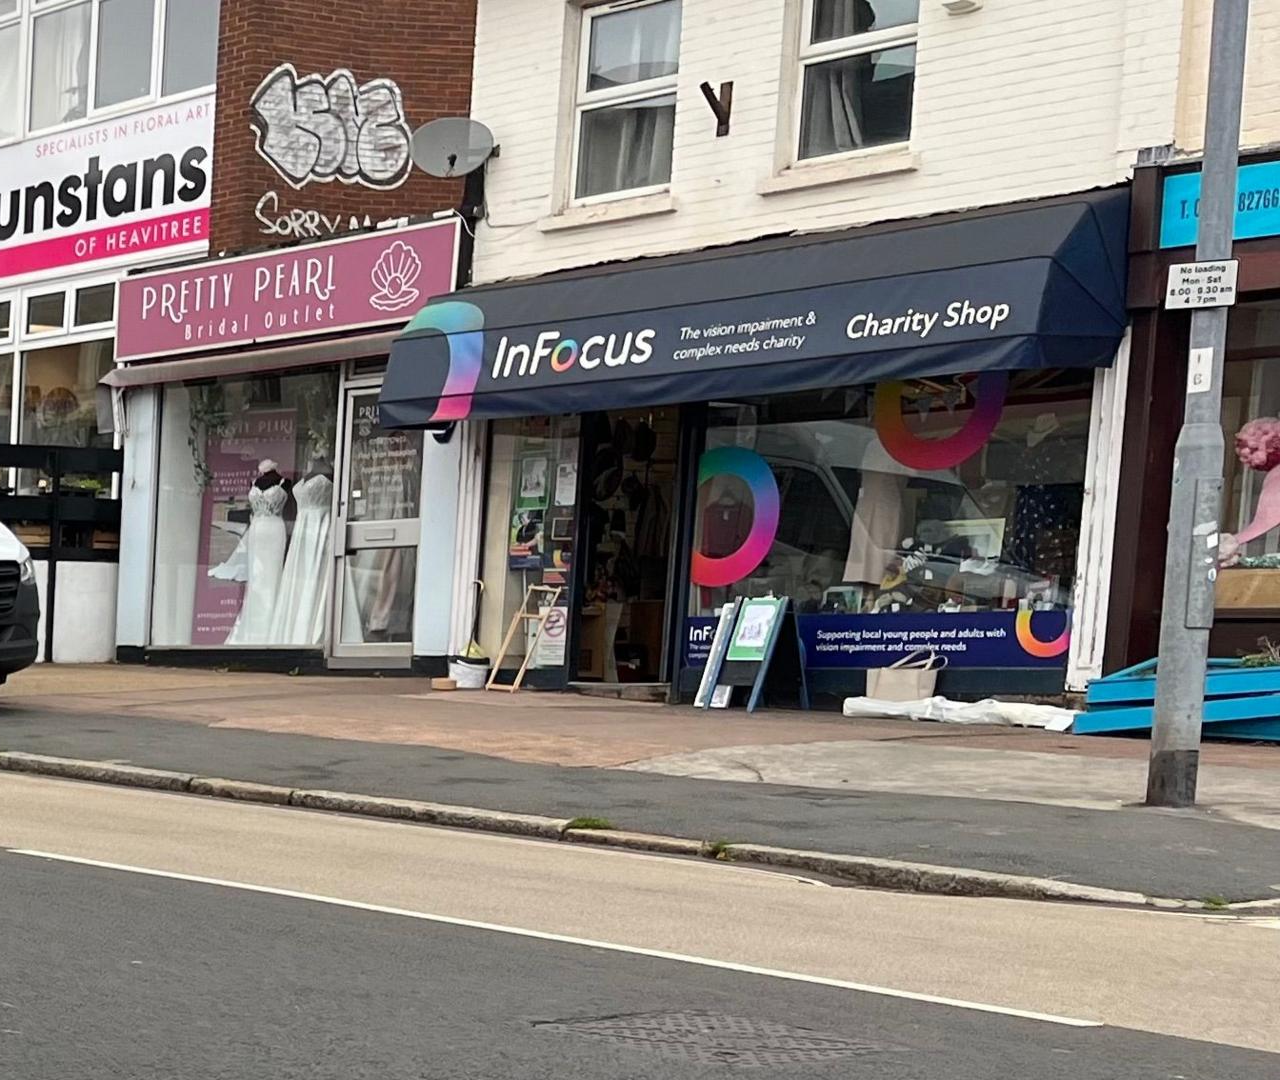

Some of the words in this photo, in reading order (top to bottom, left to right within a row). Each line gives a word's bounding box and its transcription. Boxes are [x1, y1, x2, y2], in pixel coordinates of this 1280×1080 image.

[35, 128, 109, 159] SPECIALISTS
[114, 123, 128, 140] IN
[133, 111, 179, 136] FLORAL
[185, 103, 211, 120] ART
[1238, 187, 1280, 213] 82766
[74, 238, 99, 257] OF
[106, 215, 203, 252] HEAVITREE
[1180, 266, 1193, 274] No
[1194, 264, 1227, 273] loading
[1182, 277, 1200, 285] Mon
[1206, 275, 1222, 284] Sat
[142, 271, 233, 324] PRETTY
[254, 254, 336, 302] PEARL
[184, 313, 248, 341] Bridal
[264, 302, 336, 329] Outlet
[679, 326, 701, 341] The
[702, 323, 735, 338] vision
[736, 315, 805, 336] impairment
[805, 310, 817, 326] &
[846, 308, 939, 339] Charity
[943, 299, 1010, 331] Shop
[672, 343, 723, 361] complex
[723, 338, 761, 354] needs
[762, 333, 806, 350] charity
[815, 641, 839, 652] vision
[839, 642, 886, 654] impairment
[886, 641, 904, 652] and
[940, 641, 967, 652] needs
[816, 629, 862, 642] Supporting
[862, 628, 882, 639] local
[882, 630, 909, 641] young
[909, 628, 939, 641] people
[940, 627, 957, 638] and
[957, 627, 985, 638] adults
[985, 627, 1007, 638] with
